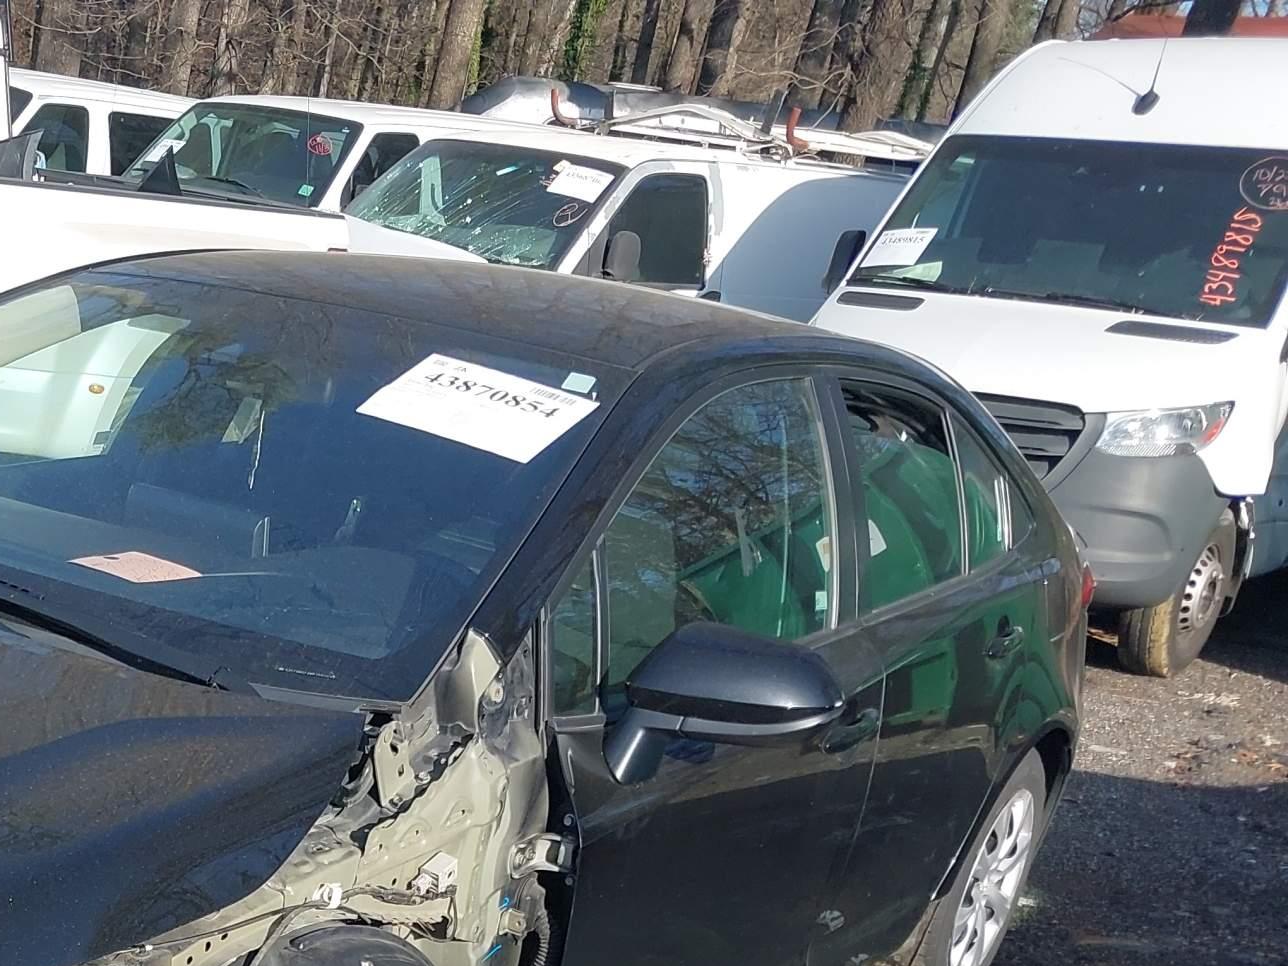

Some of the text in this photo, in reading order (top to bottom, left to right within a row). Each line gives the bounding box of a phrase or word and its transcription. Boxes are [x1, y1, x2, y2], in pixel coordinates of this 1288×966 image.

[1253, 166, 1288, 182] 10/2
[1200, 207, 1261, 306] 43489815
[424, 373, 559, 417] 43870854
